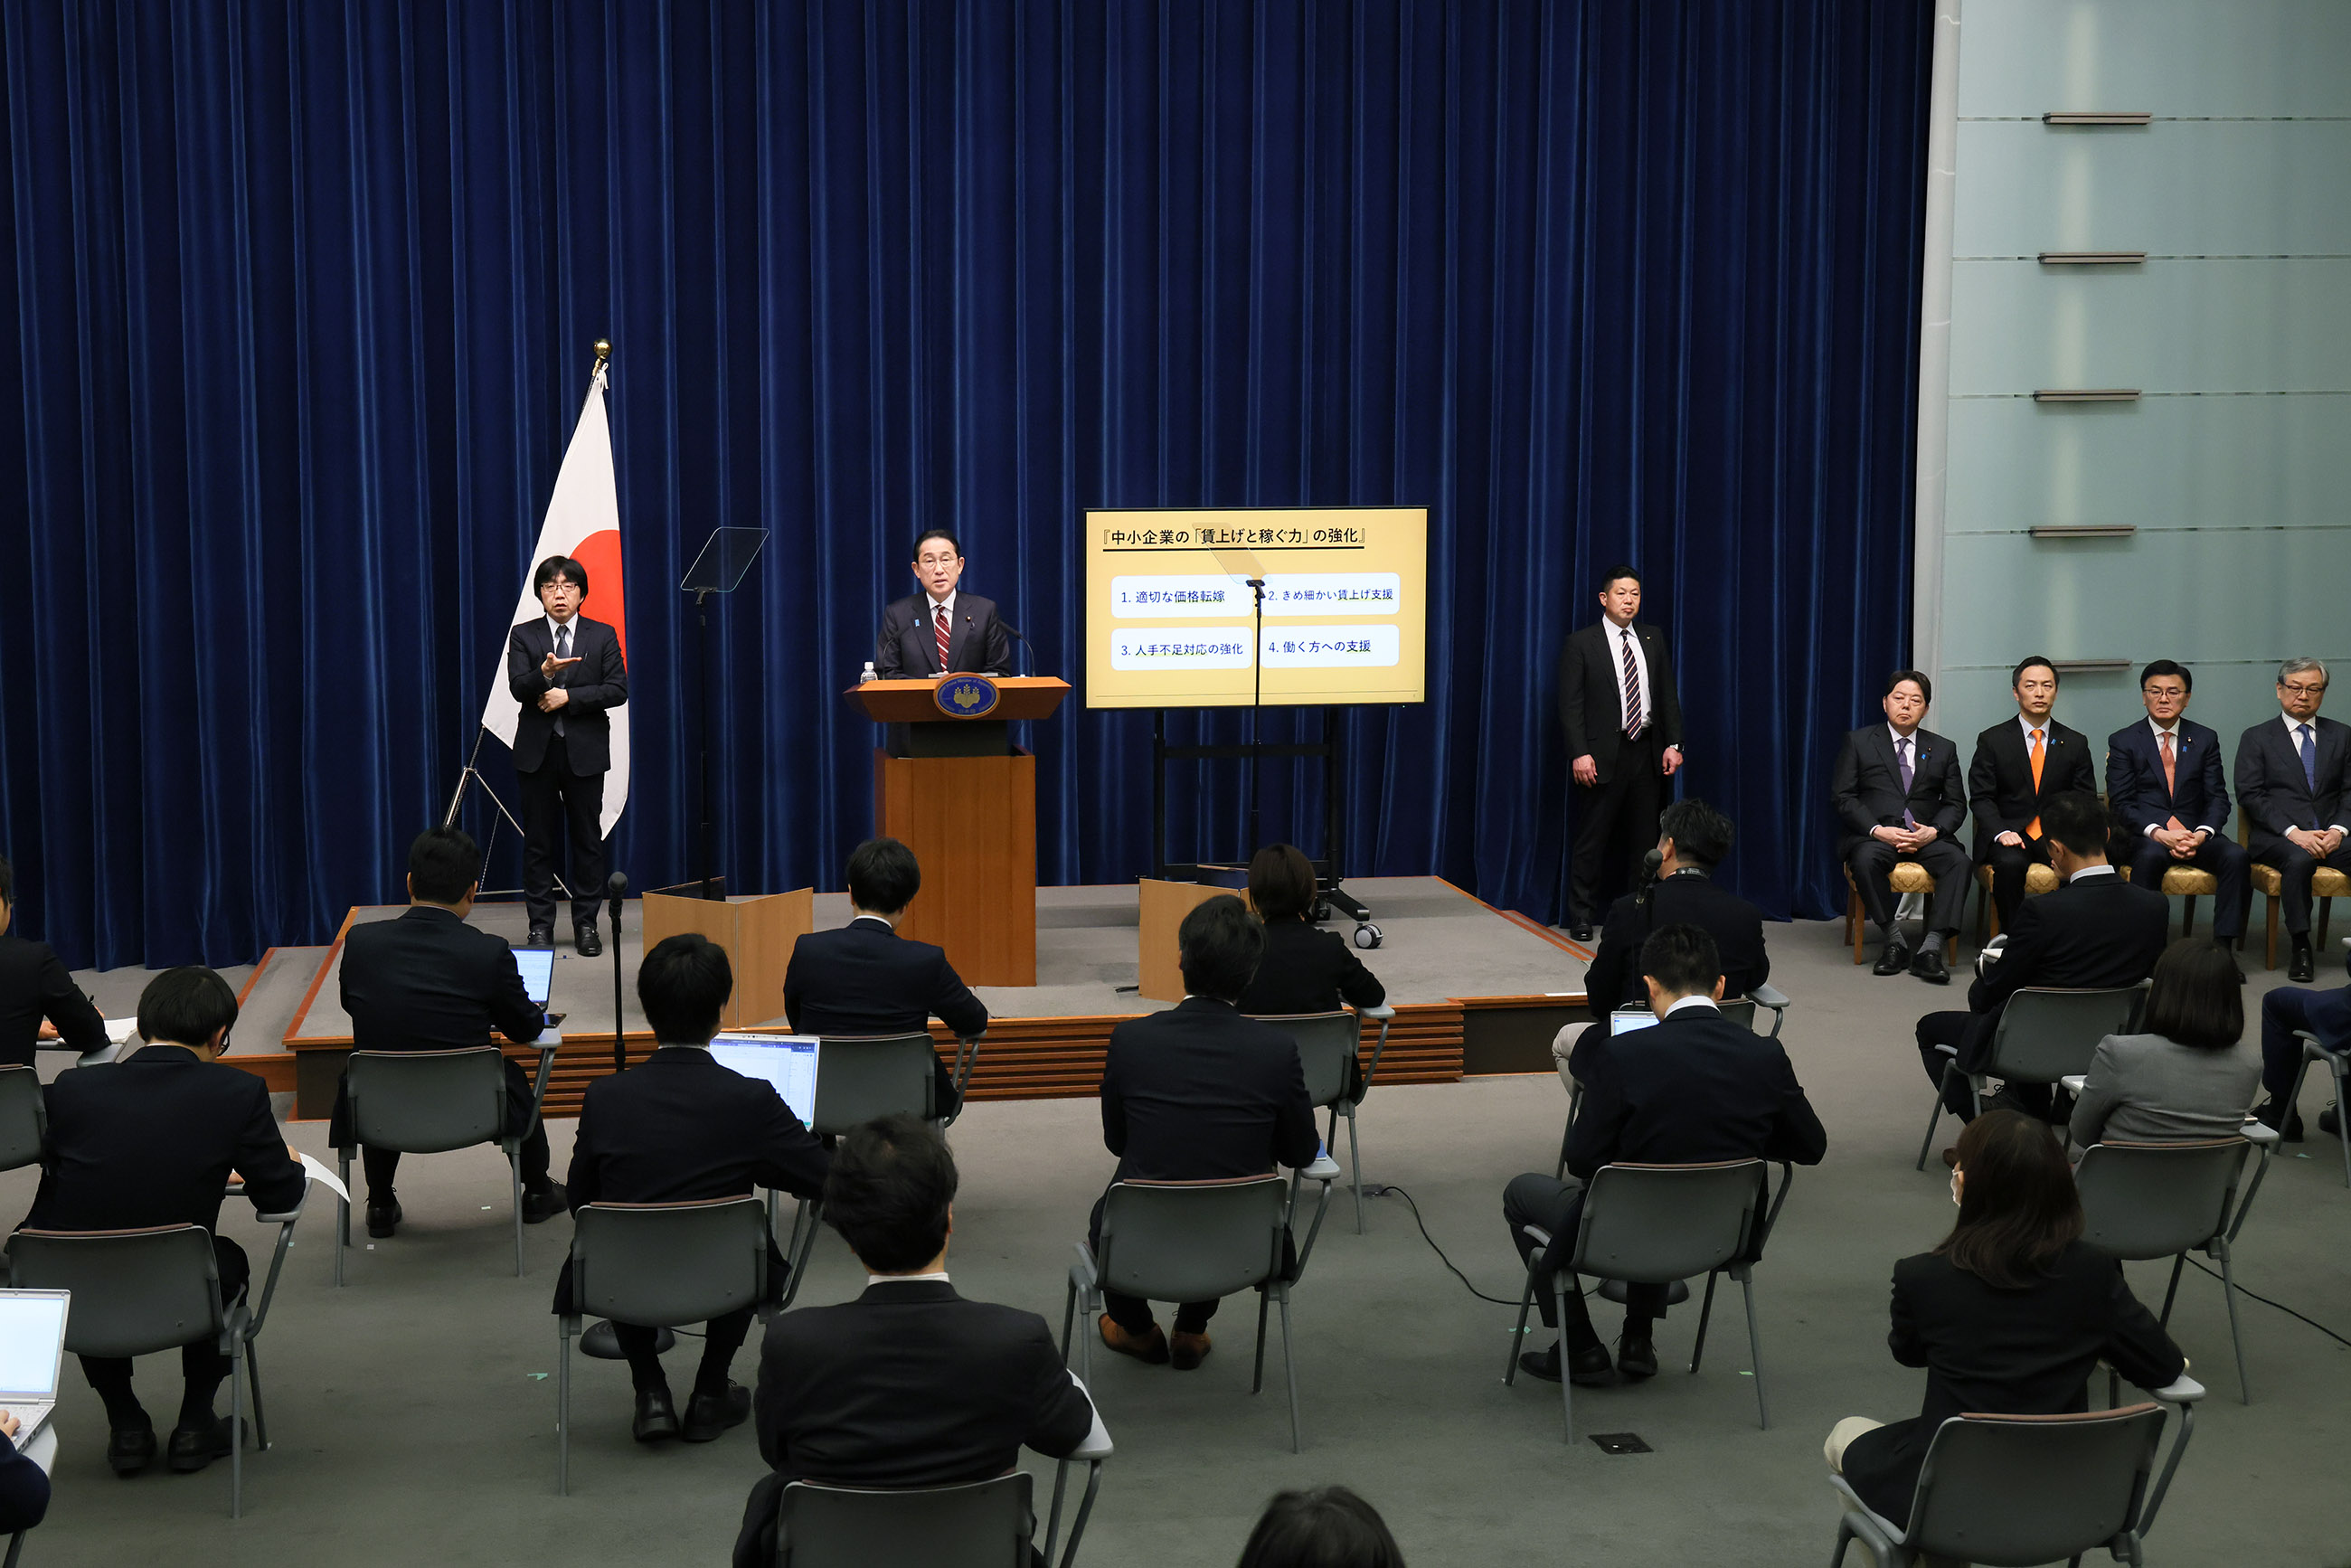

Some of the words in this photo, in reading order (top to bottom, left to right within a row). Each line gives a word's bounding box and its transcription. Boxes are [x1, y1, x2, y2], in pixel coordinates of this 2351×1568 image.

[1121, 592, 1131, 603] 1.
[1136, 590, 1225, 603] 適切な価格転嫁
[1268, 590, 1278, 600] 2.
[1282, 589, 1393, 601] きめ細かい賃上げ支援
[1121, 645, 1131, 656] 3.
[1136, 643, 1243, 656] 人手不足対応の強化
[1269, 642, 1279, 653] 4.
[1283, 639, 1371, 653] 働く方への支援
